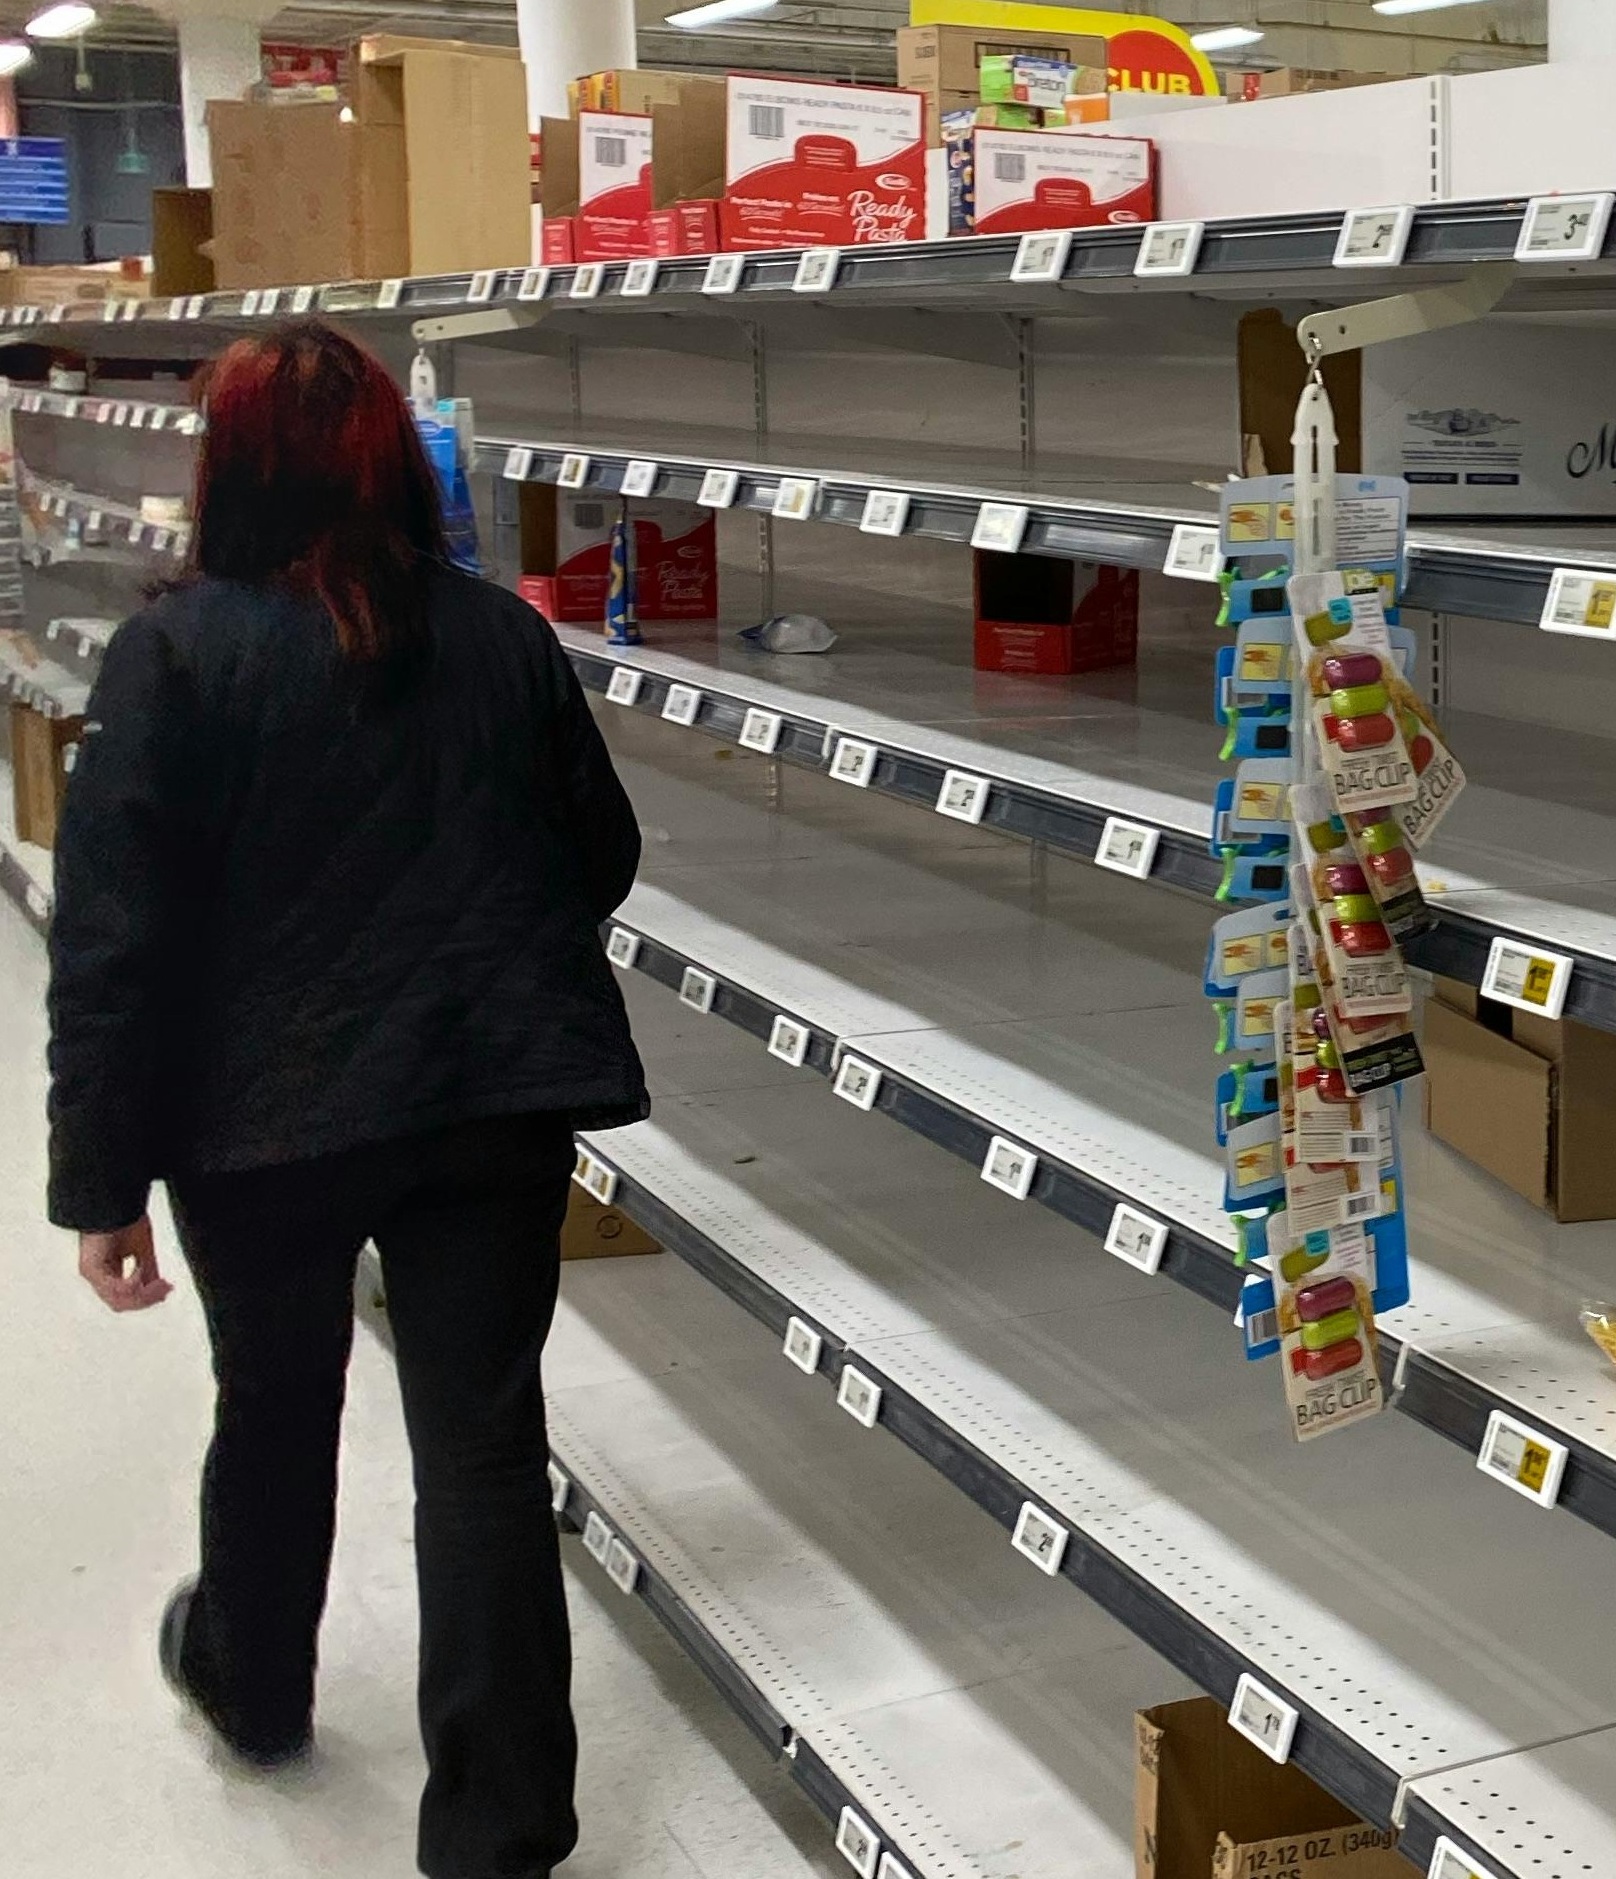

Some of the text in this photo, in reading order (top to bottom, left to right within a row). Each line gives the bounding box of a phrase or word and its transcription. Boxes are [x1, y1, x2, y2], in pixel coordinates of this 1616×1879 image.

[847, 190, 917, 228] Ready
[852, 215, 908, 242] Pasta
[656, 561, 711, 582] Ready
[1334, 762, 1411, 795] BAG CLIP
[1428, 759, 1456, 798] CLIP
[1296, 1391, 1337, 1426] BAG
[1339, 1379, 1377, 1409] CLIP
[1247, 1845, 1299, 1872] 12-12
